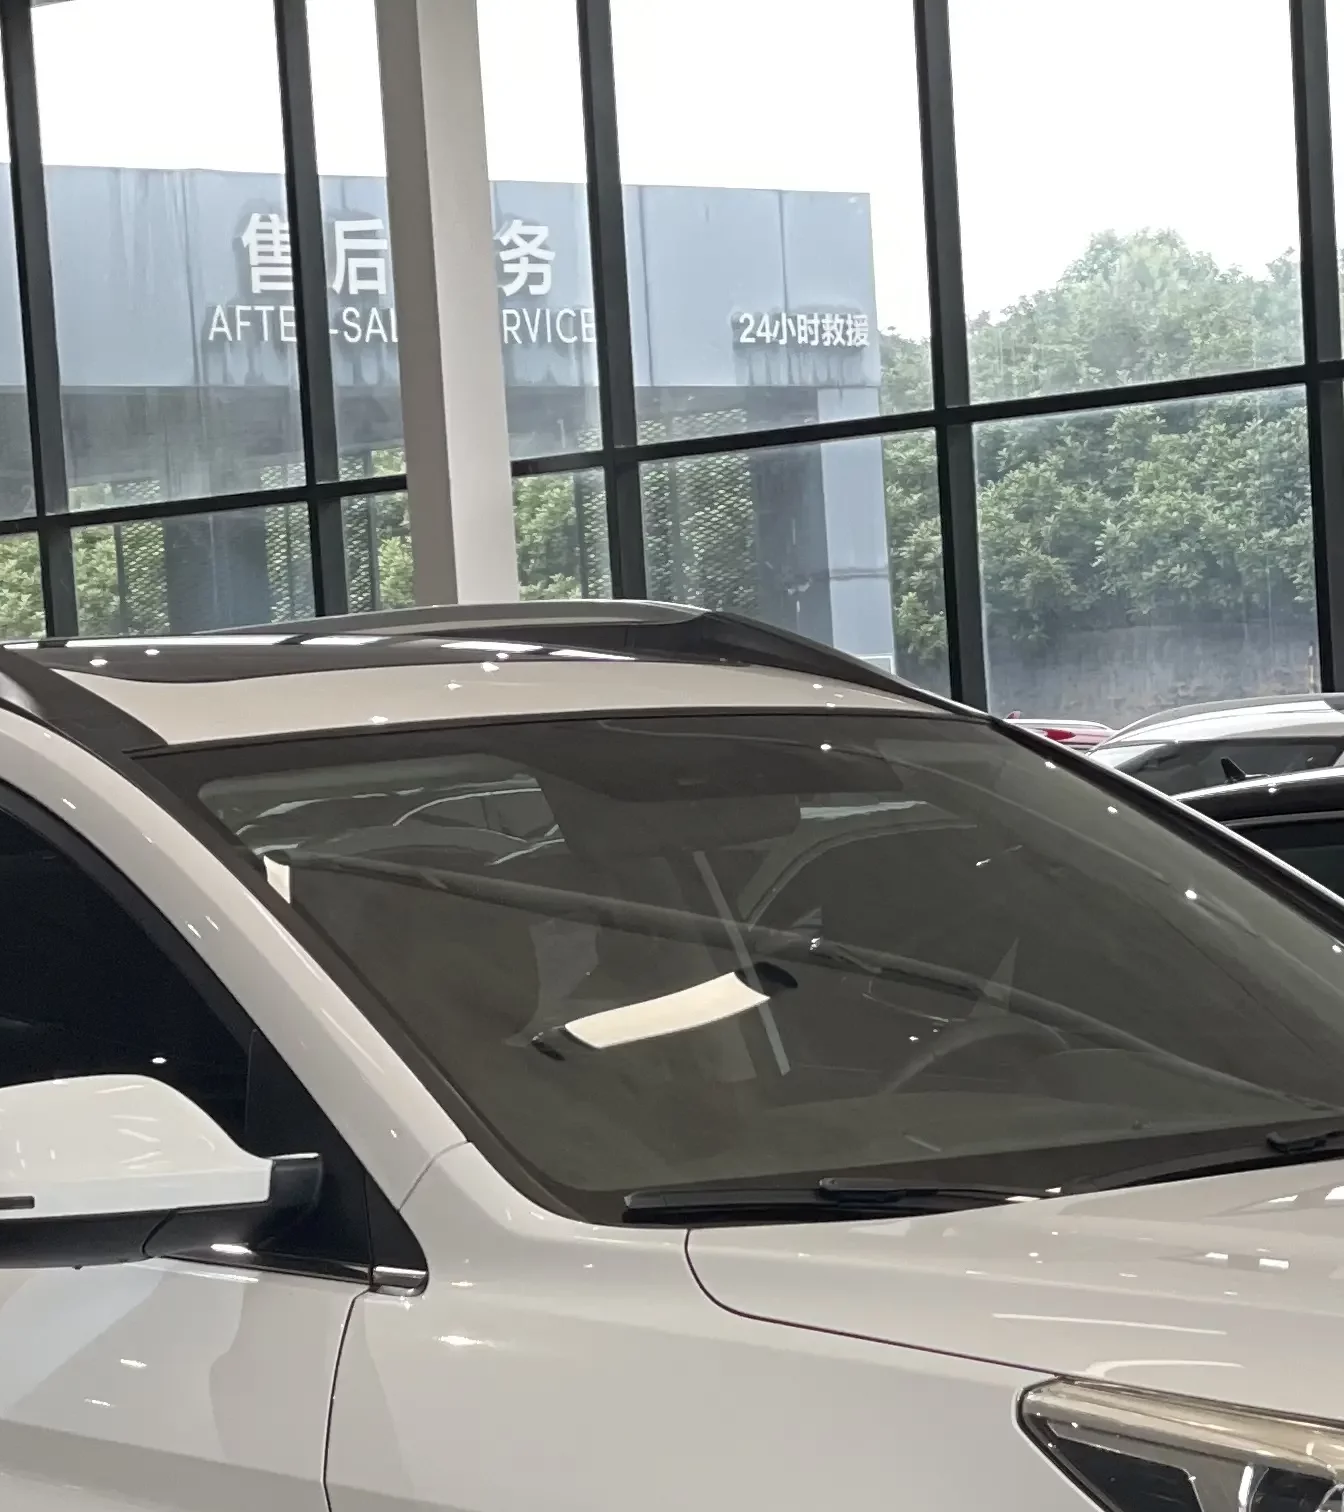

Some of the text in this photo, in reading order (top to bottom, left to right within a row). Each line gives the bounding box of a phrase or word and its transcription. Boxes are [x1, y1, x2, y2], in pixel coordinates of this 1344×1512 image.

[241, 212, 556, 297] 售后务
[502, 307, 597, 344] RVICE
[739, 312, 870, 347] 24小时救援
